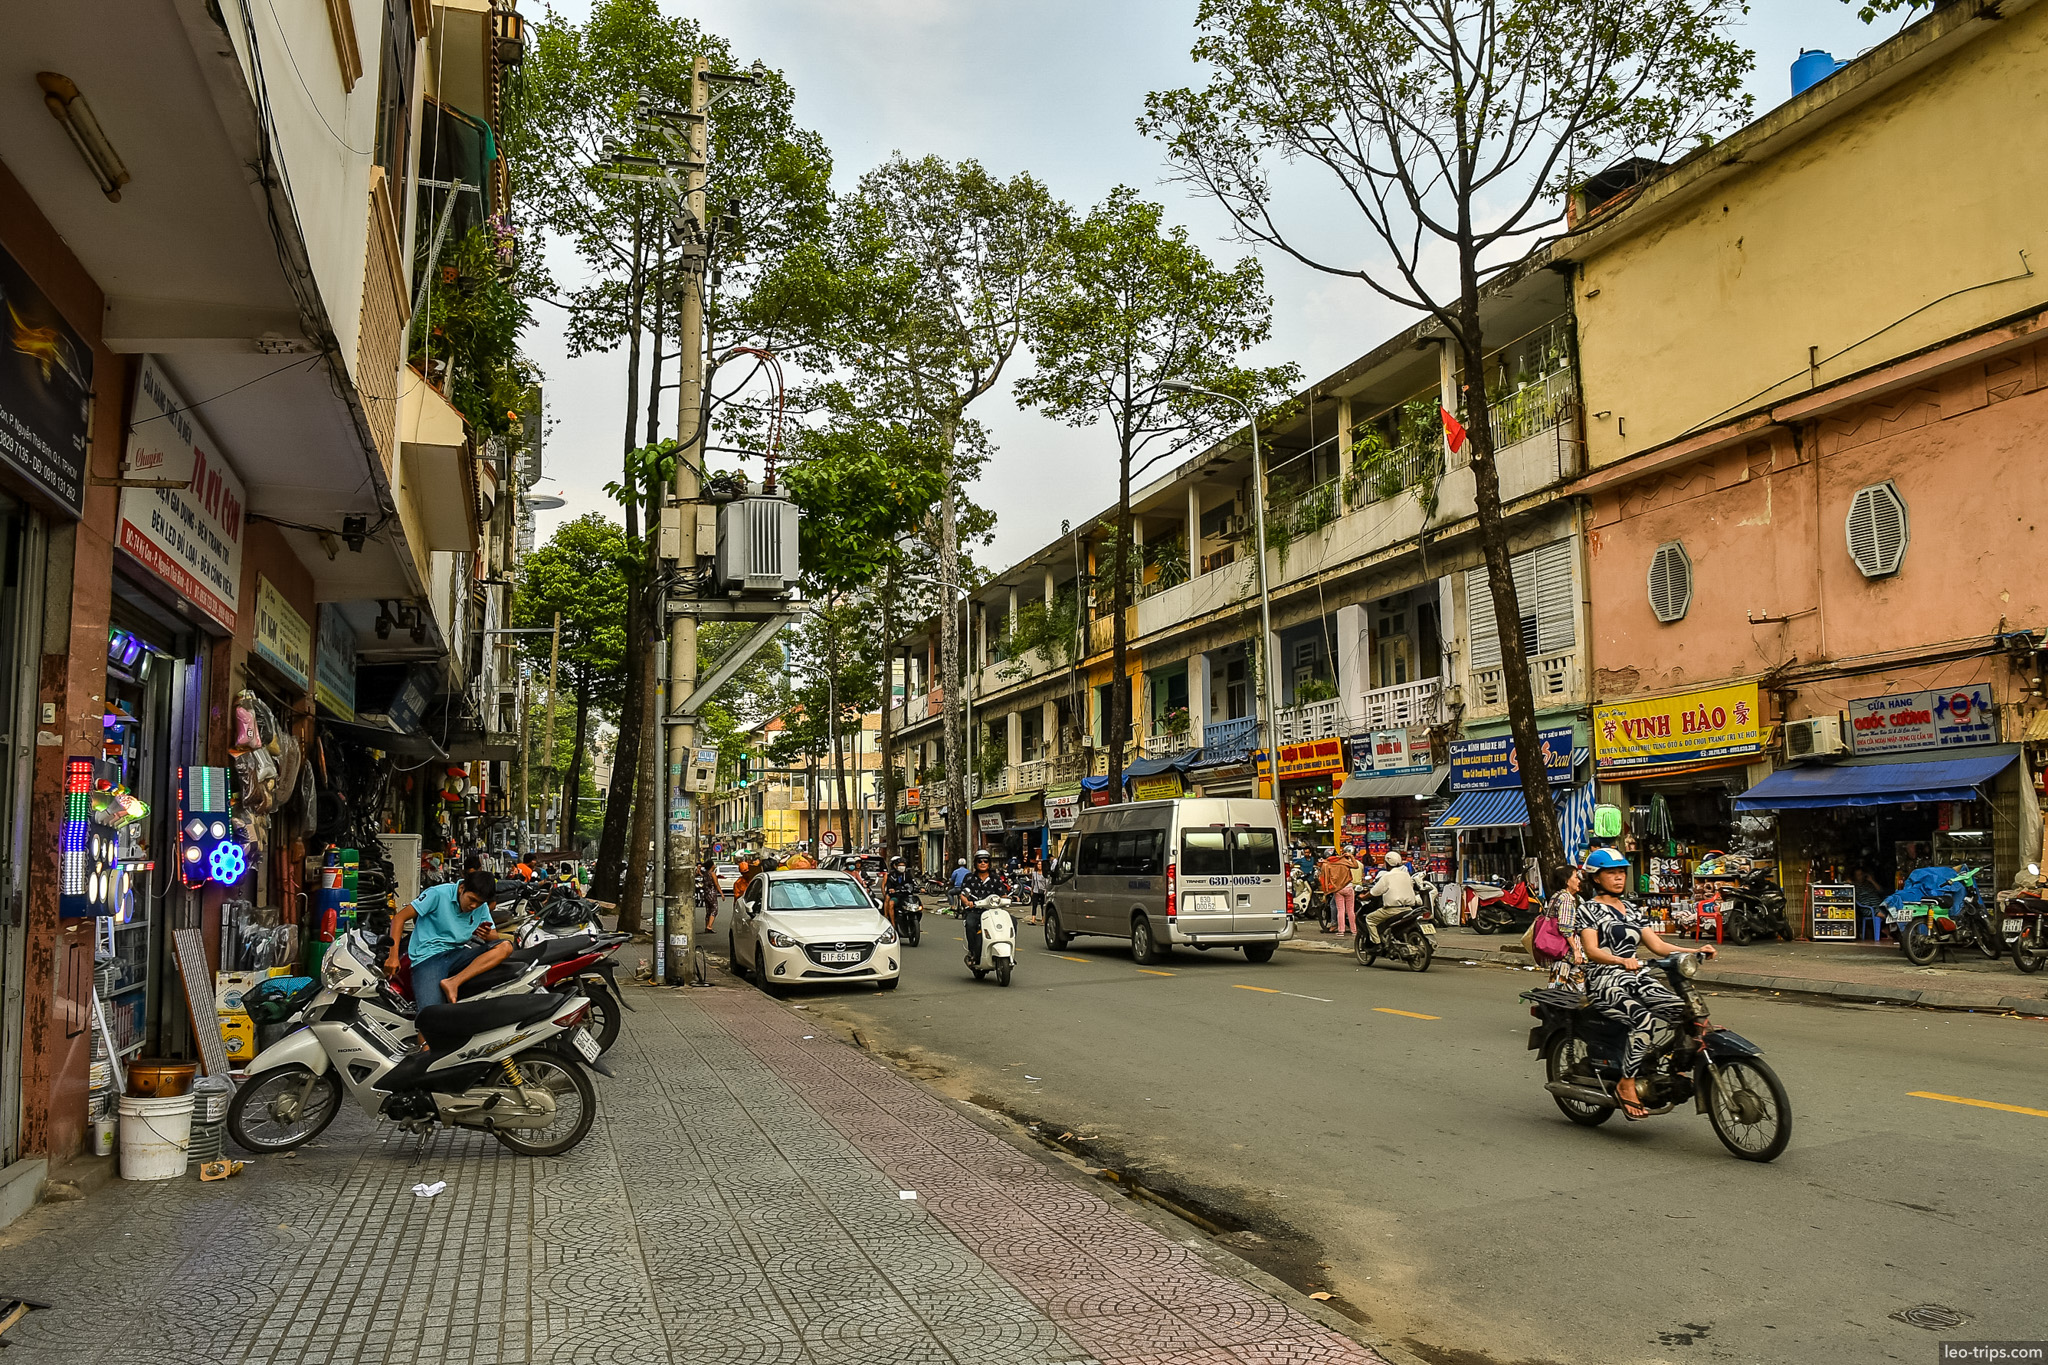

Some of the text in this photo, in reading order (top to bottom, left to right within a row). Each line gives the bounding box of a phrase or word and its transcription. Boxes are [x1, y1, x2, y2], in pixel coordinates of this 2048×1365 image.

[0, 404, 8, 424] on,
[15, 418, 32, 440] Nguyễn
[33, 433, 41, 450] Thái
[15, 441, 29, 464] 7135
[44, 466, 56, 486] 0918
[57, 476, 66, 494] 131
[170, 492, 179, 515] GIA
[180, 502, 194, 530] DỤNG
[134, 534, 140, 552] 74
[152, 508, 165, 536] ĐÈN
[165, 522, 176, 546] LED
[186, 541, 197, 567] LOẠI
[1732, 700, 1750, 726] 豪
[1868, 698, 1913, 711] CỬA HÀNG
[1622, 703, 1726, 741] VINH HÀO
[1854, 708, 1932, 731] QUỐC CƯỜNG
[1491, 742, 1498, 750] XE
[1548, 750, 1573, 768] Decal
[1054, 807, 1072, 818] 281
